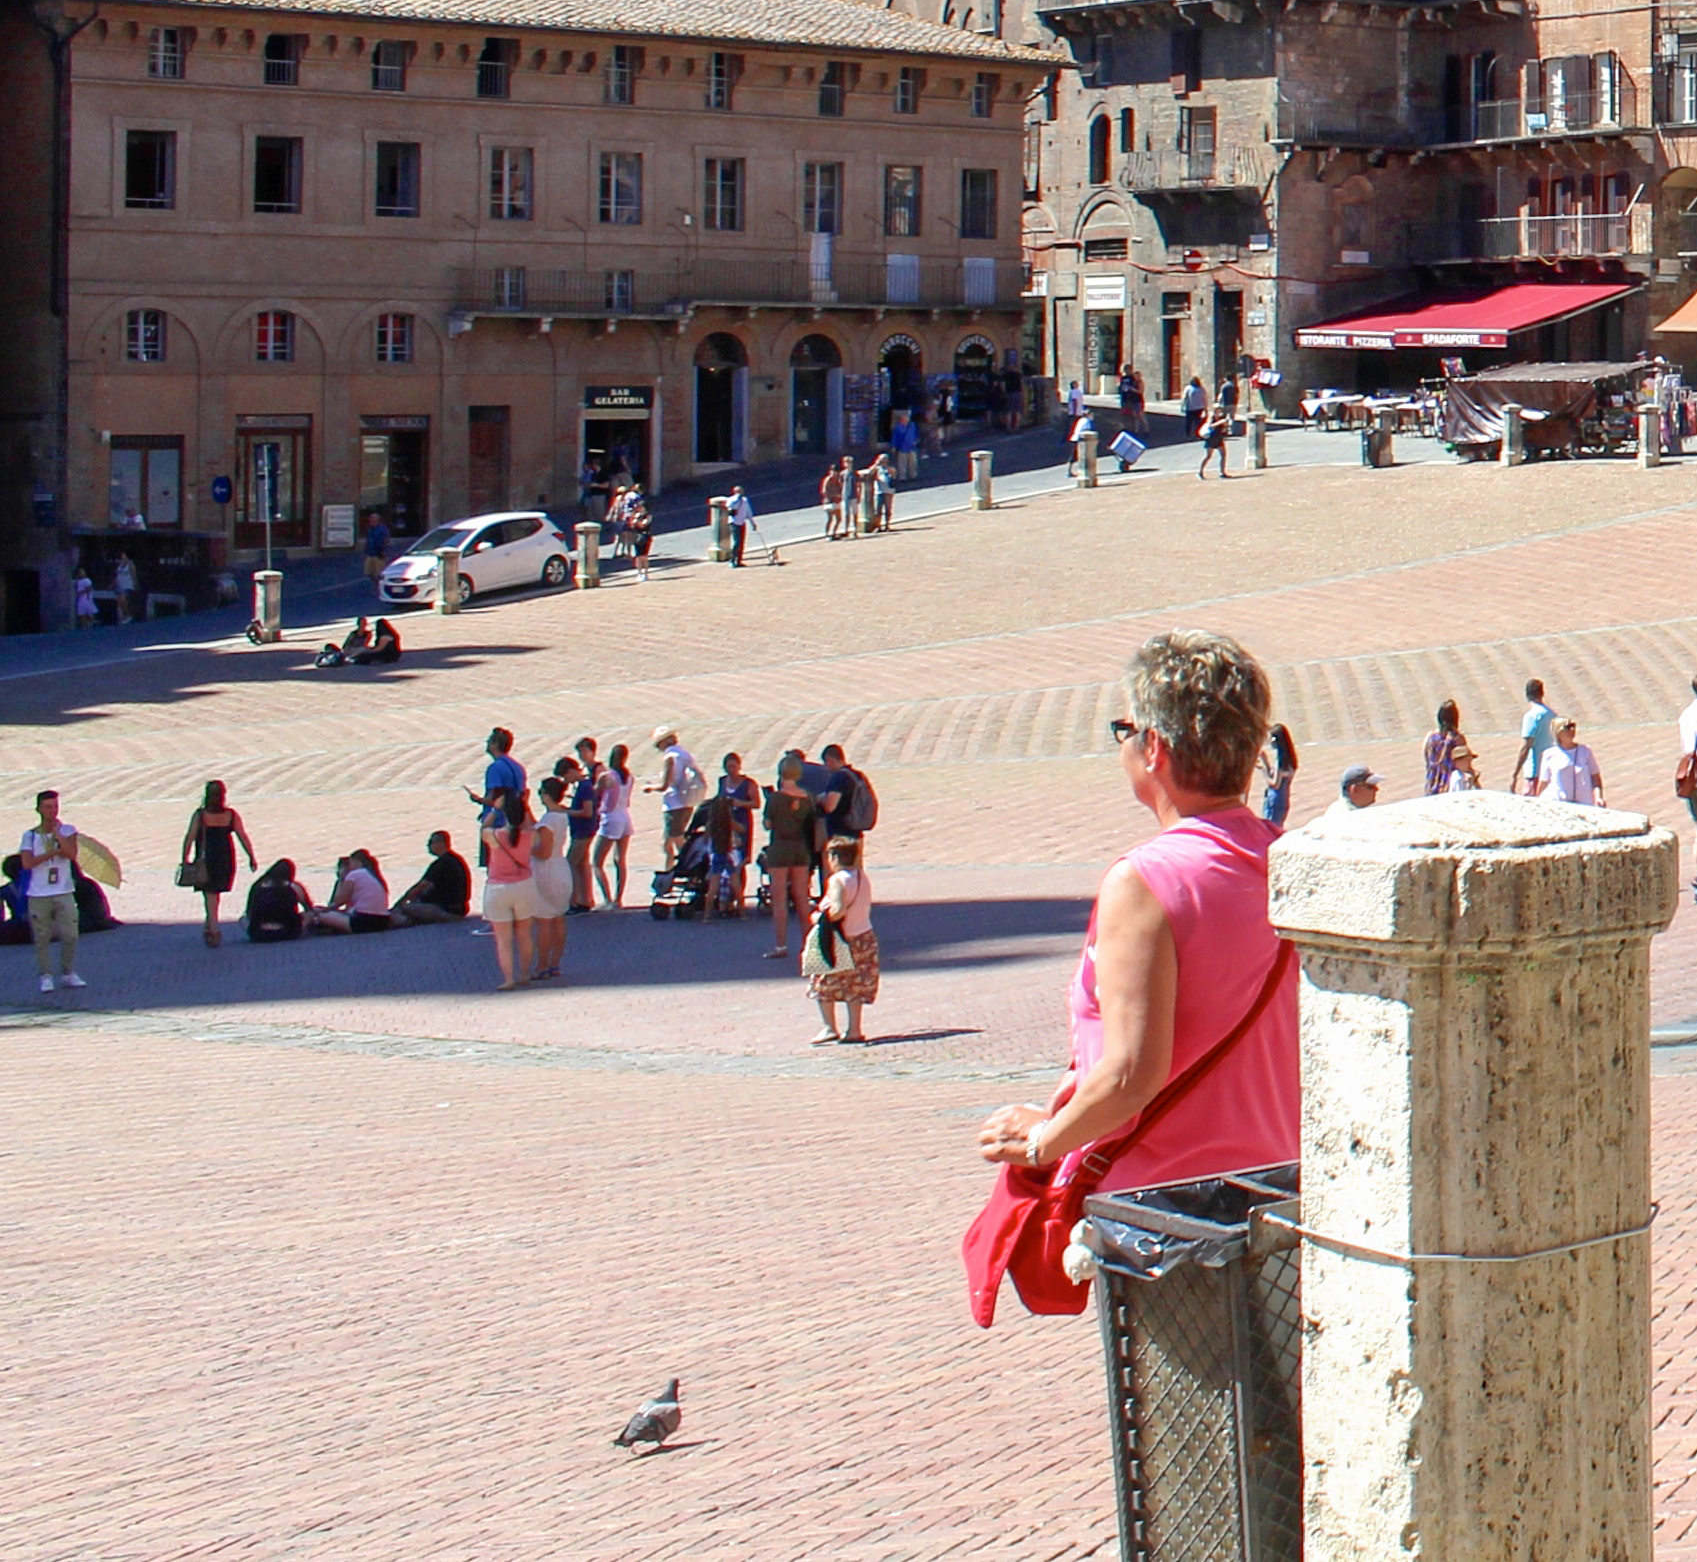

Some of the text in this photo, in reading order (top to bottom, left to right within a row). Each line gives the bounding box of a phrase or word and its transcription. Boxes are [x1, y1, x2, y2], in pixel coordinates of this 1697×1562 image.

[1352, 337, 1393, 349] PIZZERIA
[1422, 333, 1480, 345] SPADAFORTE
[595, 397, 645, 405] GELATERIA
